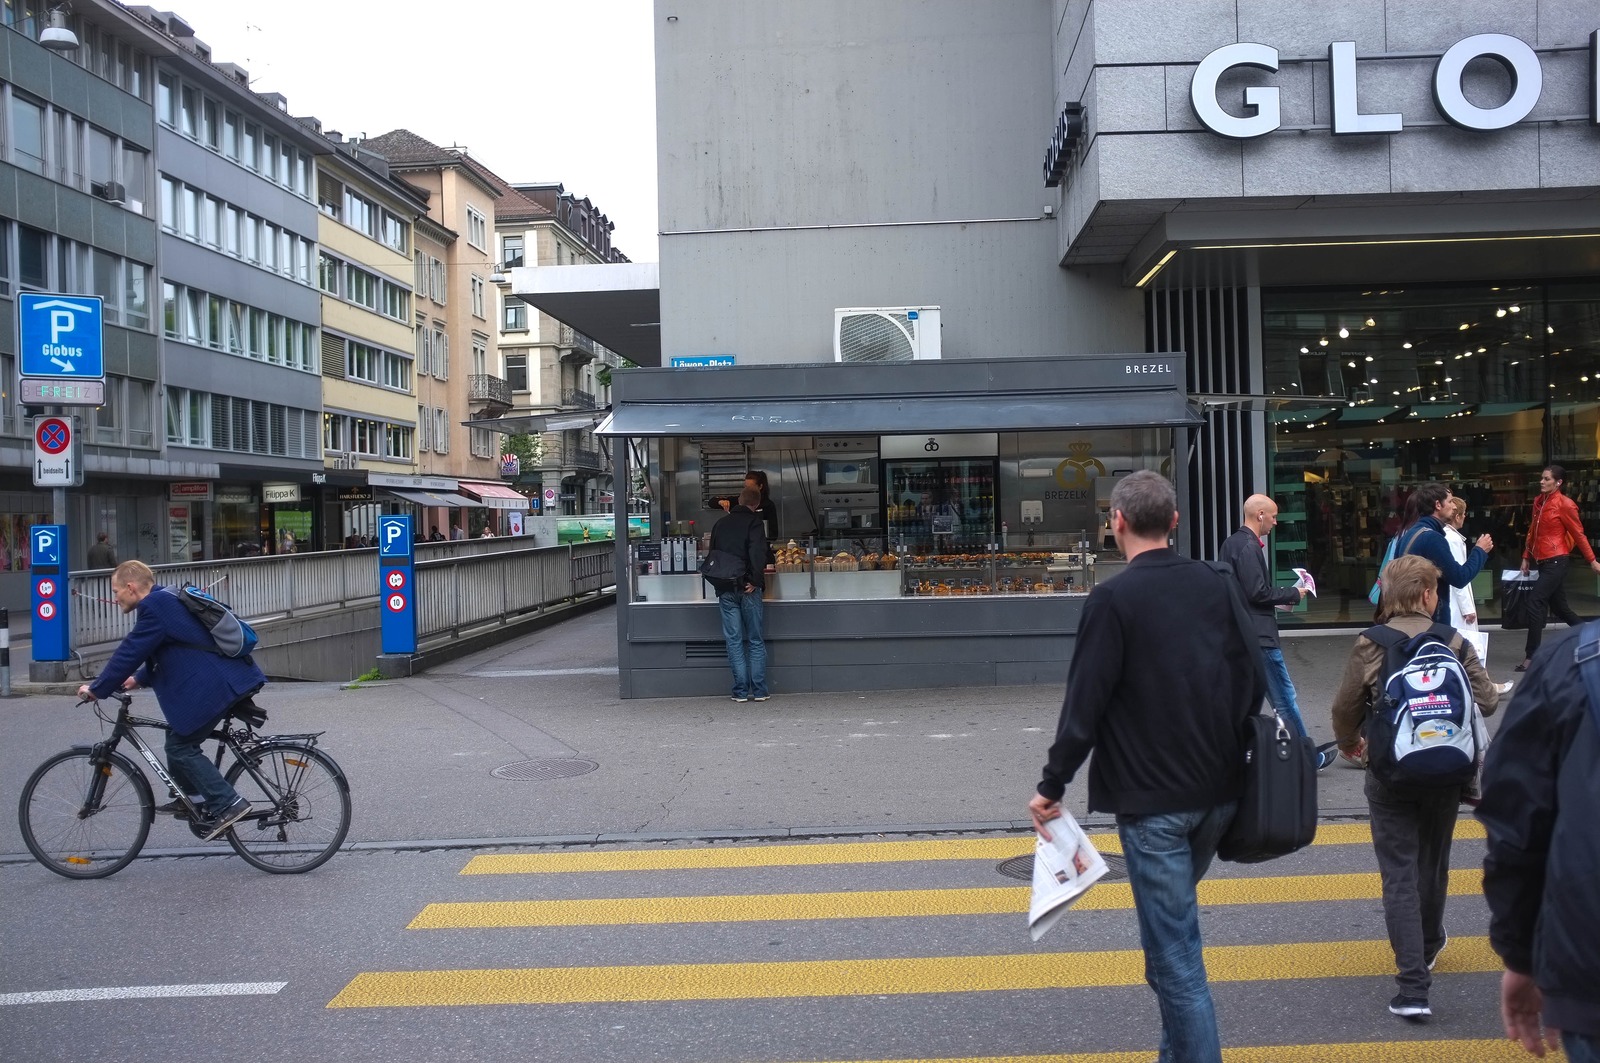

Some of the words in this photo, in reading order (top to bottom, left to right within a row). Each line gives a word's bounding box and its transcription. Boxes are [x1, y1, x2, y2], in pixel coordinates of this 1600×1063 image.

[1190, 30, 1600, 140] GLO
[51, 310, 74, 344] P
[42, 344, 82, 357] Globus
[1125, 364, 1172, 374] BREZEL
[41, 386, 80, 398] FREI
[265, 489, 288, 500] Filippa
[289, 489, 295, 497] K
[387, 526, 401, 544] P
[38, 535, 52, 552] P
[393, 599, 400, 607] 10
[43, 606, 50, 614] 10
[141, 748, 186, 799] SCOTT
